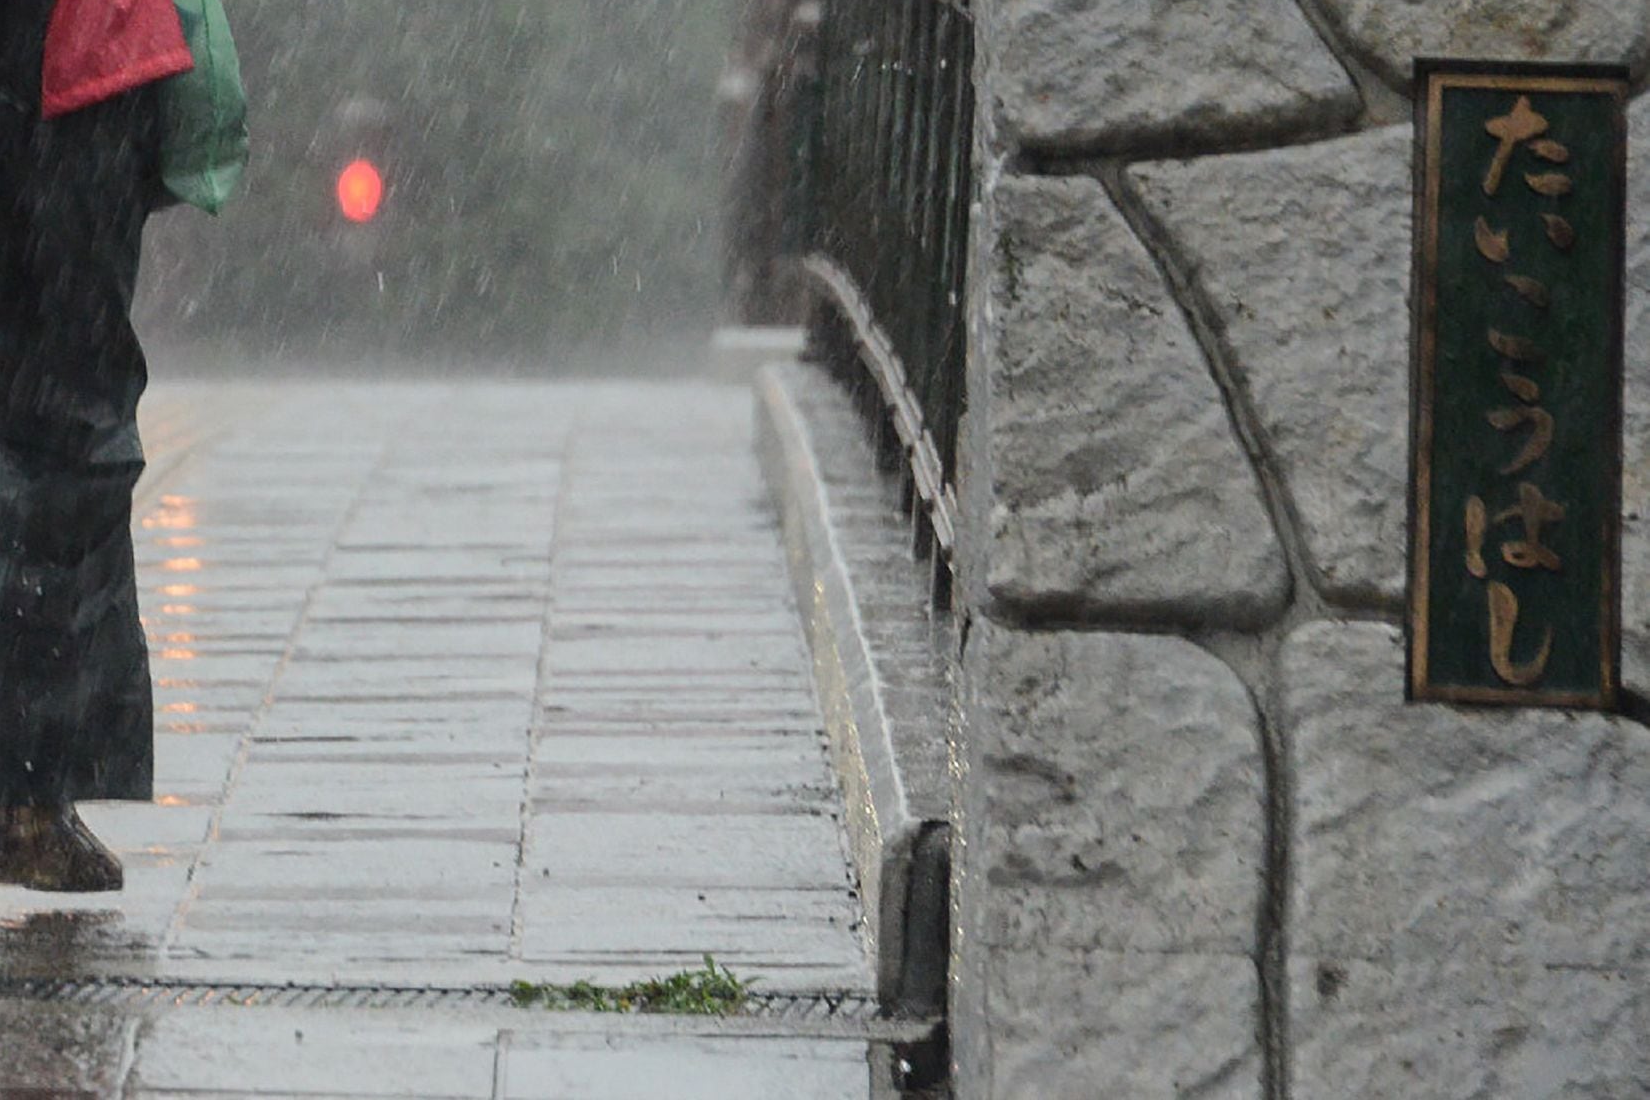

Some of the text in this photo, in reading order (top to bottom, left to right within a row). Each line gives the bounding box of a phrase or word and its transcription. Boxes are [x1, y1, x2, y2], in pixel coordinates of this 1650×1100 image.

[1465, 95, 1575, 686] たいこうはし
